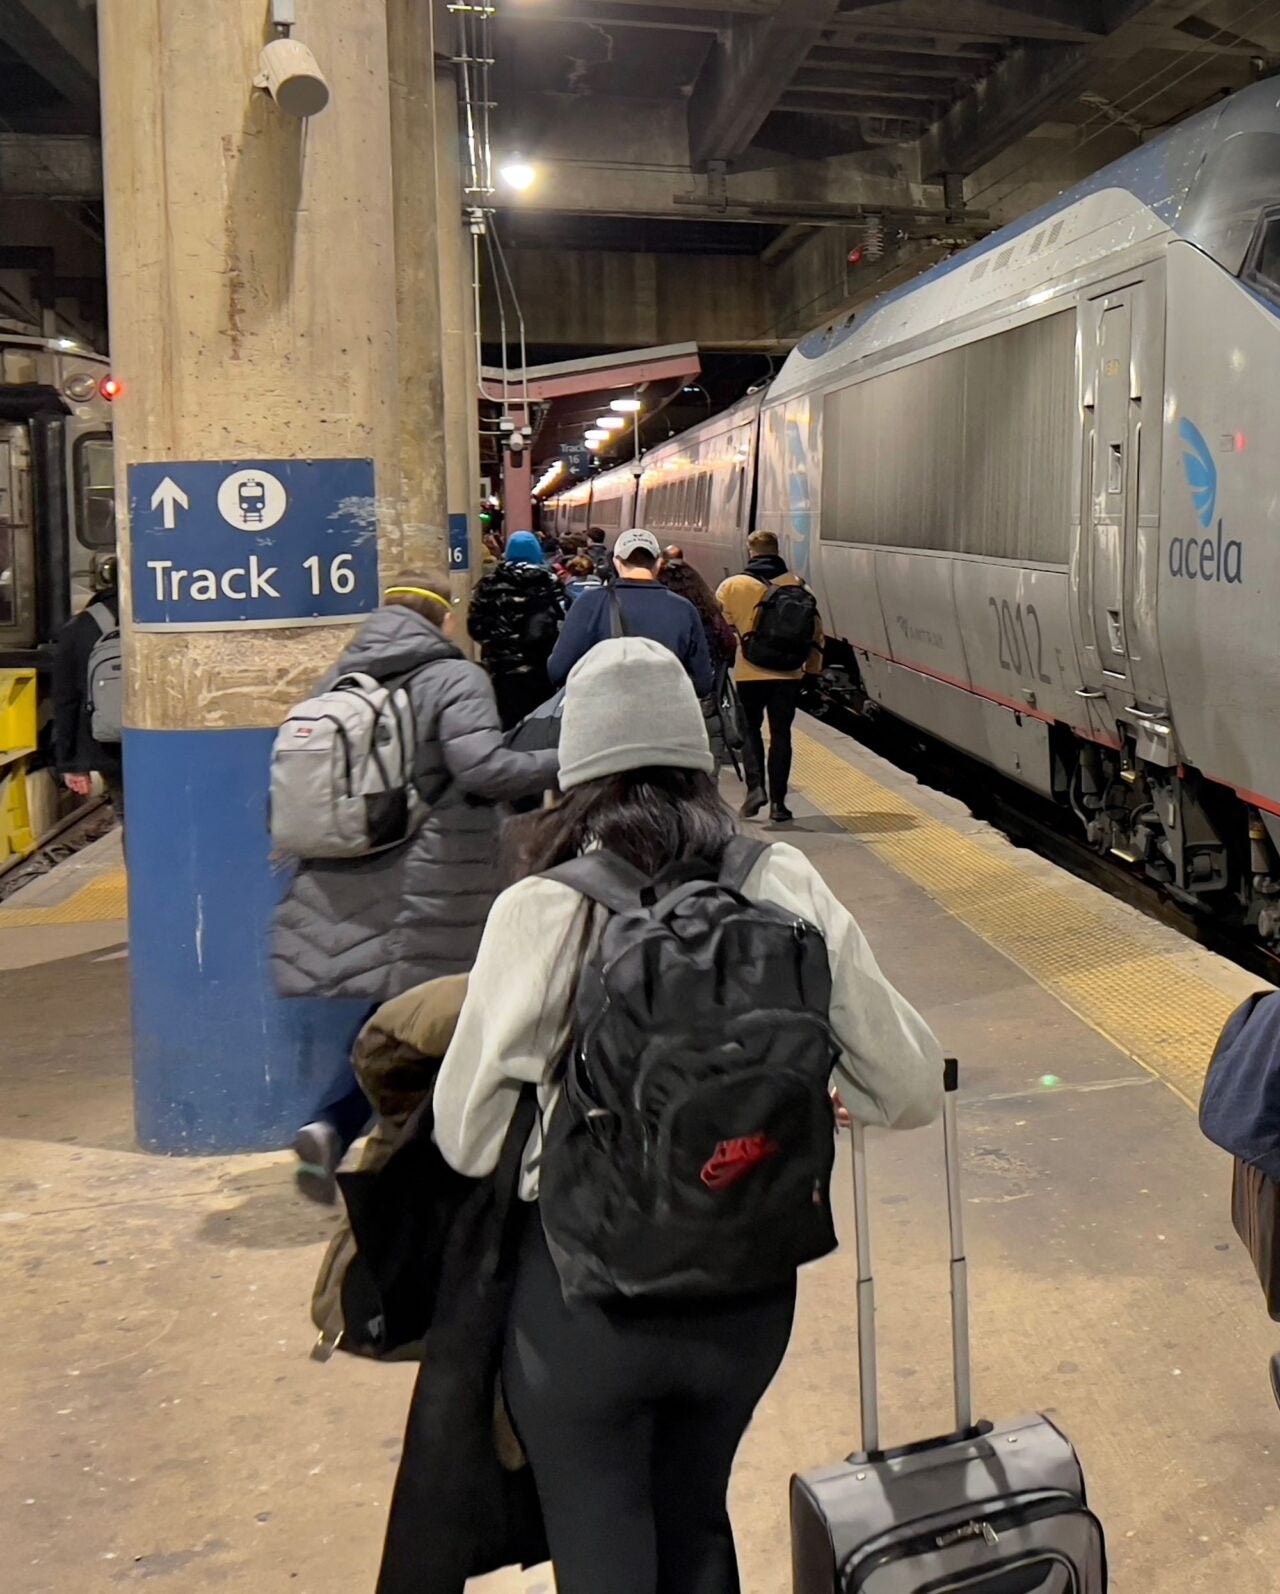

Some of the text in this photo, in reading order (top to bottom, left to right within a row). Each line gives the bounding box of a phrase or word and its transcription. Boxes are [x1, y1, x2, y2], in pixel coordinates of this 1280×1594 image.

[568, 454, 580, 464] 16
[147, 554, 355, 601] Track 16
[1168, 518, 1242, 584] acela
[989, 597, 1051, 684] 2012
